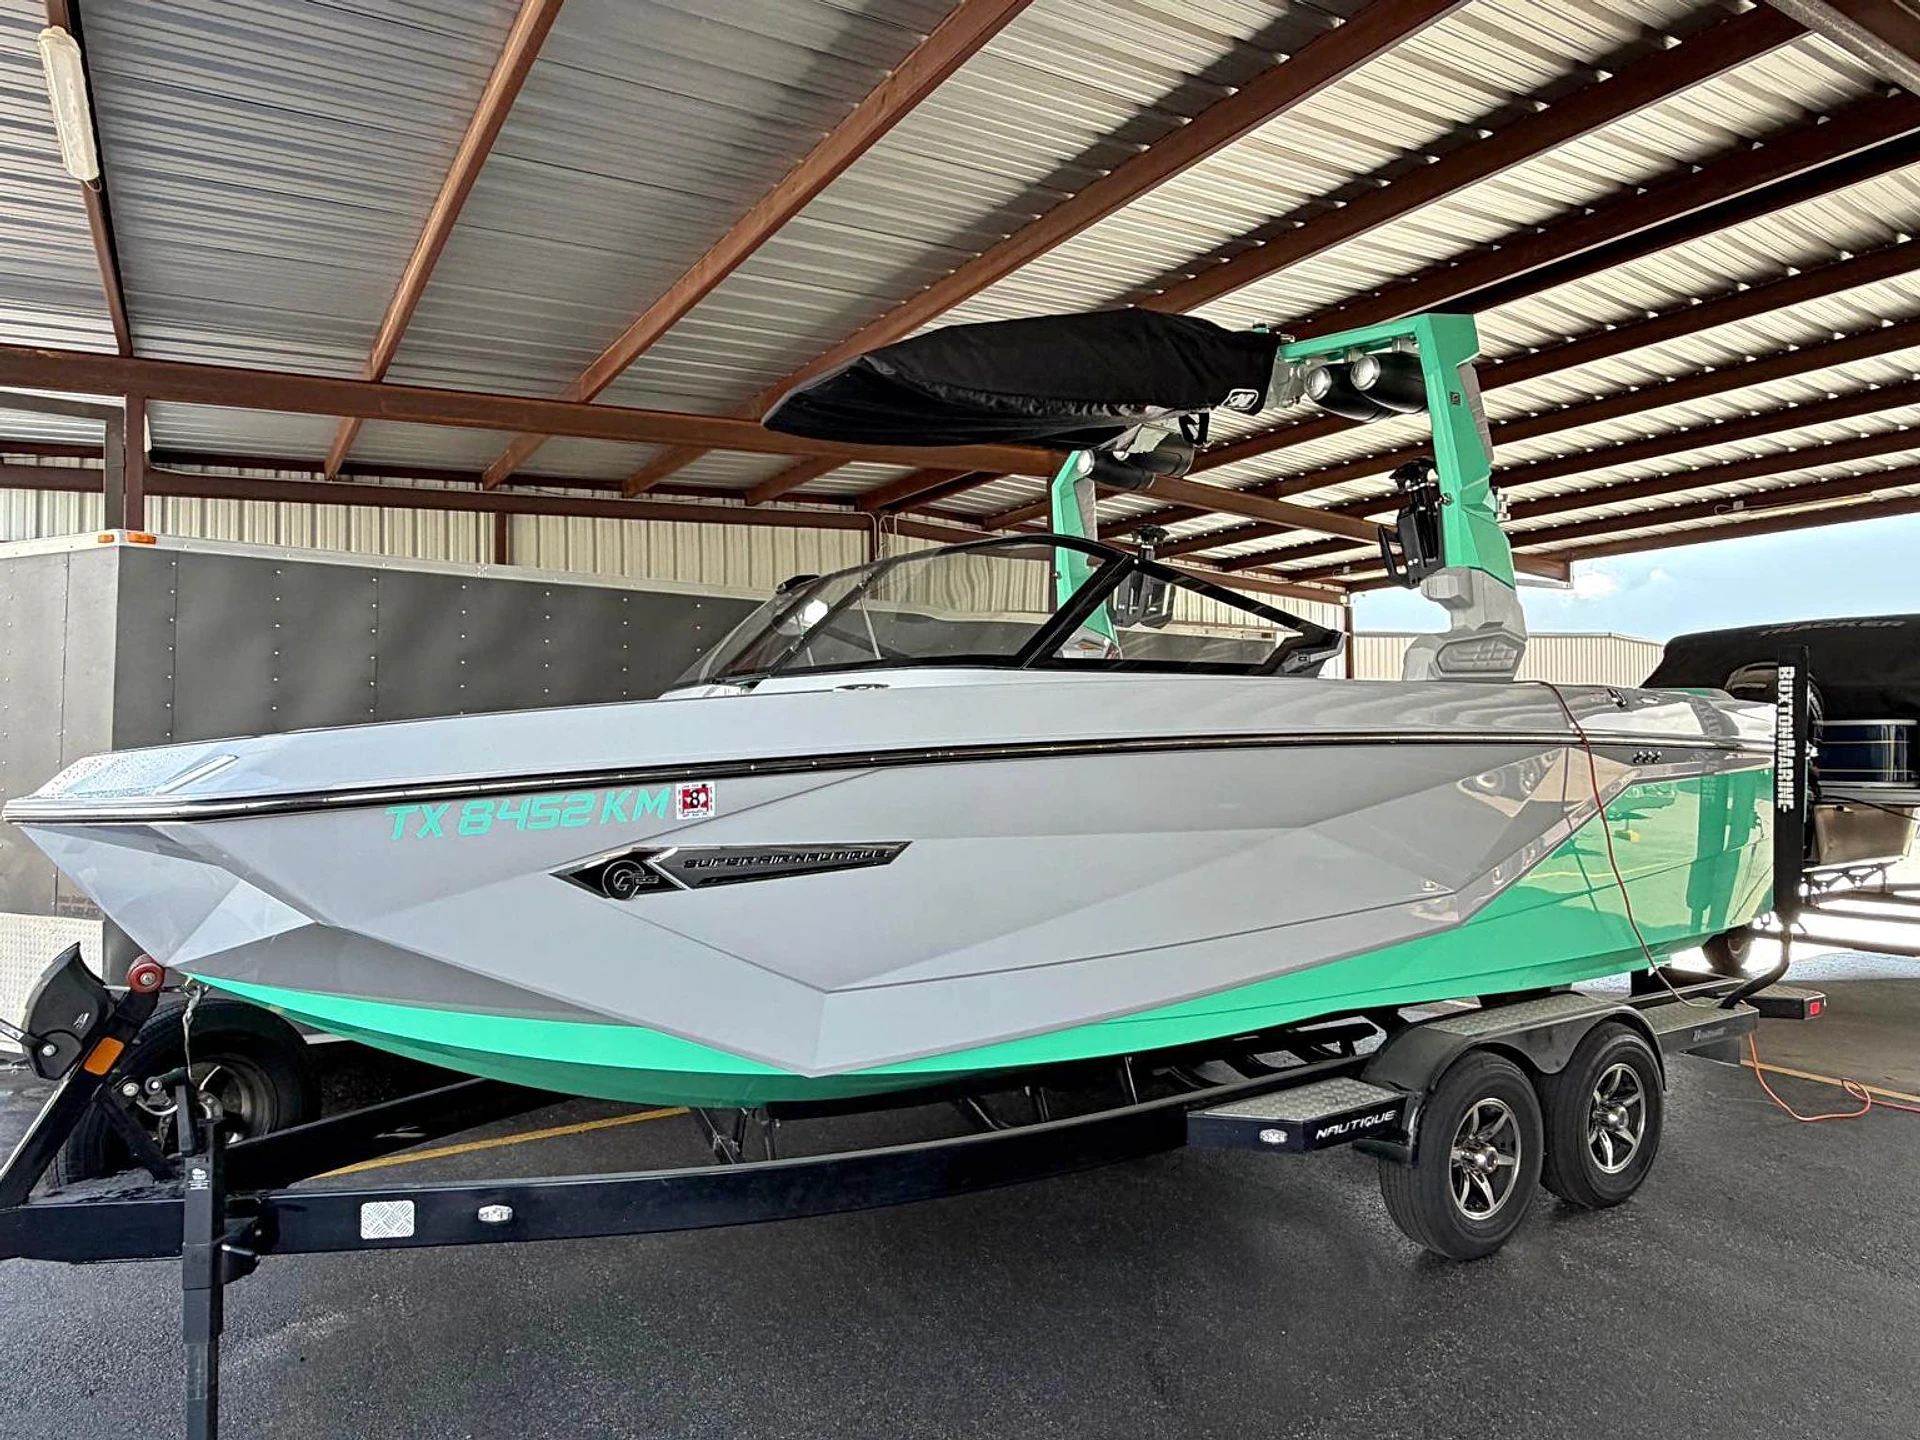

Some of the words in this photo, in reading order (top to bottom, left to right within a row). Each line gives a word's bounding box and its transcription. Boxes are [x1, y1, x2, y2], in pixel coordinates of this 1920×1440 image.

[384, 802, 451, 841] TX
[458, 790, 596, 836] 8452
[600, 786, 672, 825] KM
[1315, 1110, 1397, 1140] NAUTIQUE
